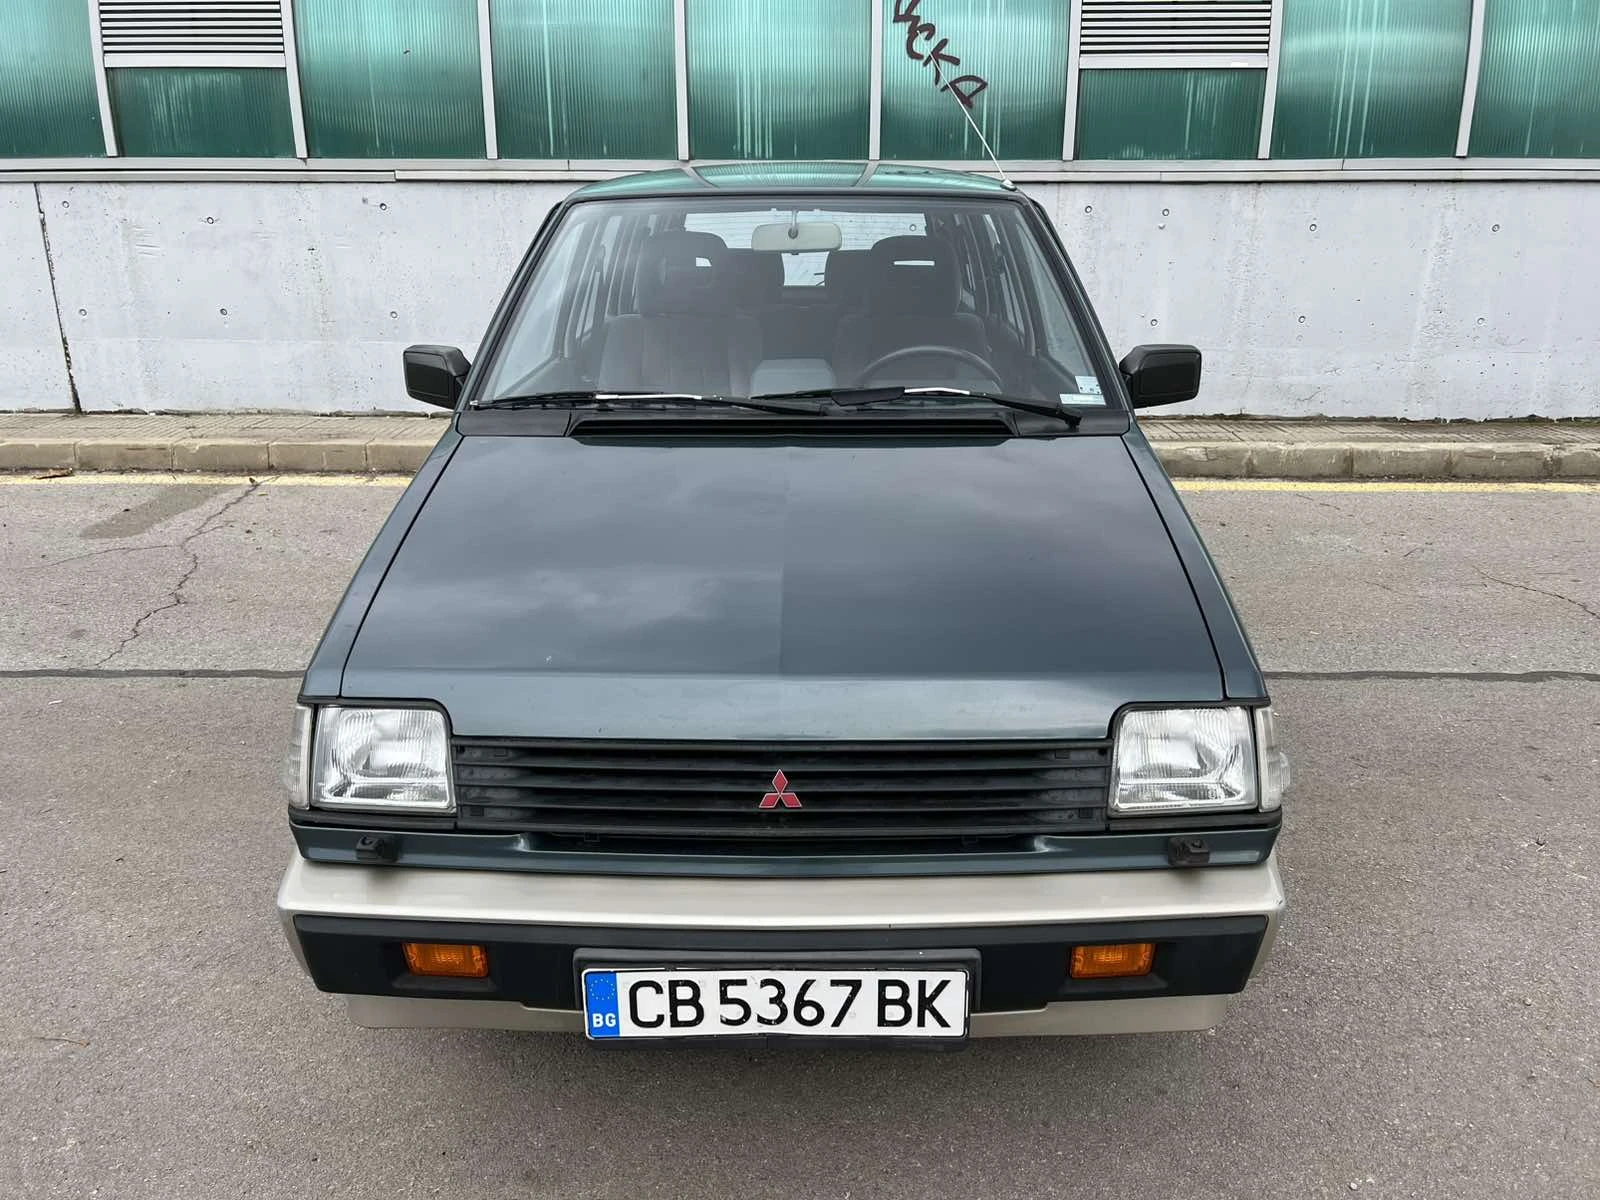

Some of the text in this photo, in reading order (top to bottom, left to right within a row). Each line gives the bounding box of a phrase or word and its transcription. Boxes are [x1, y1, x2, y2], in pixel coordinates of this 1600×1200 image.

[628, 978, 951, 1028] CB 5367 BK
[592, 1013, 617, 1028] BG
